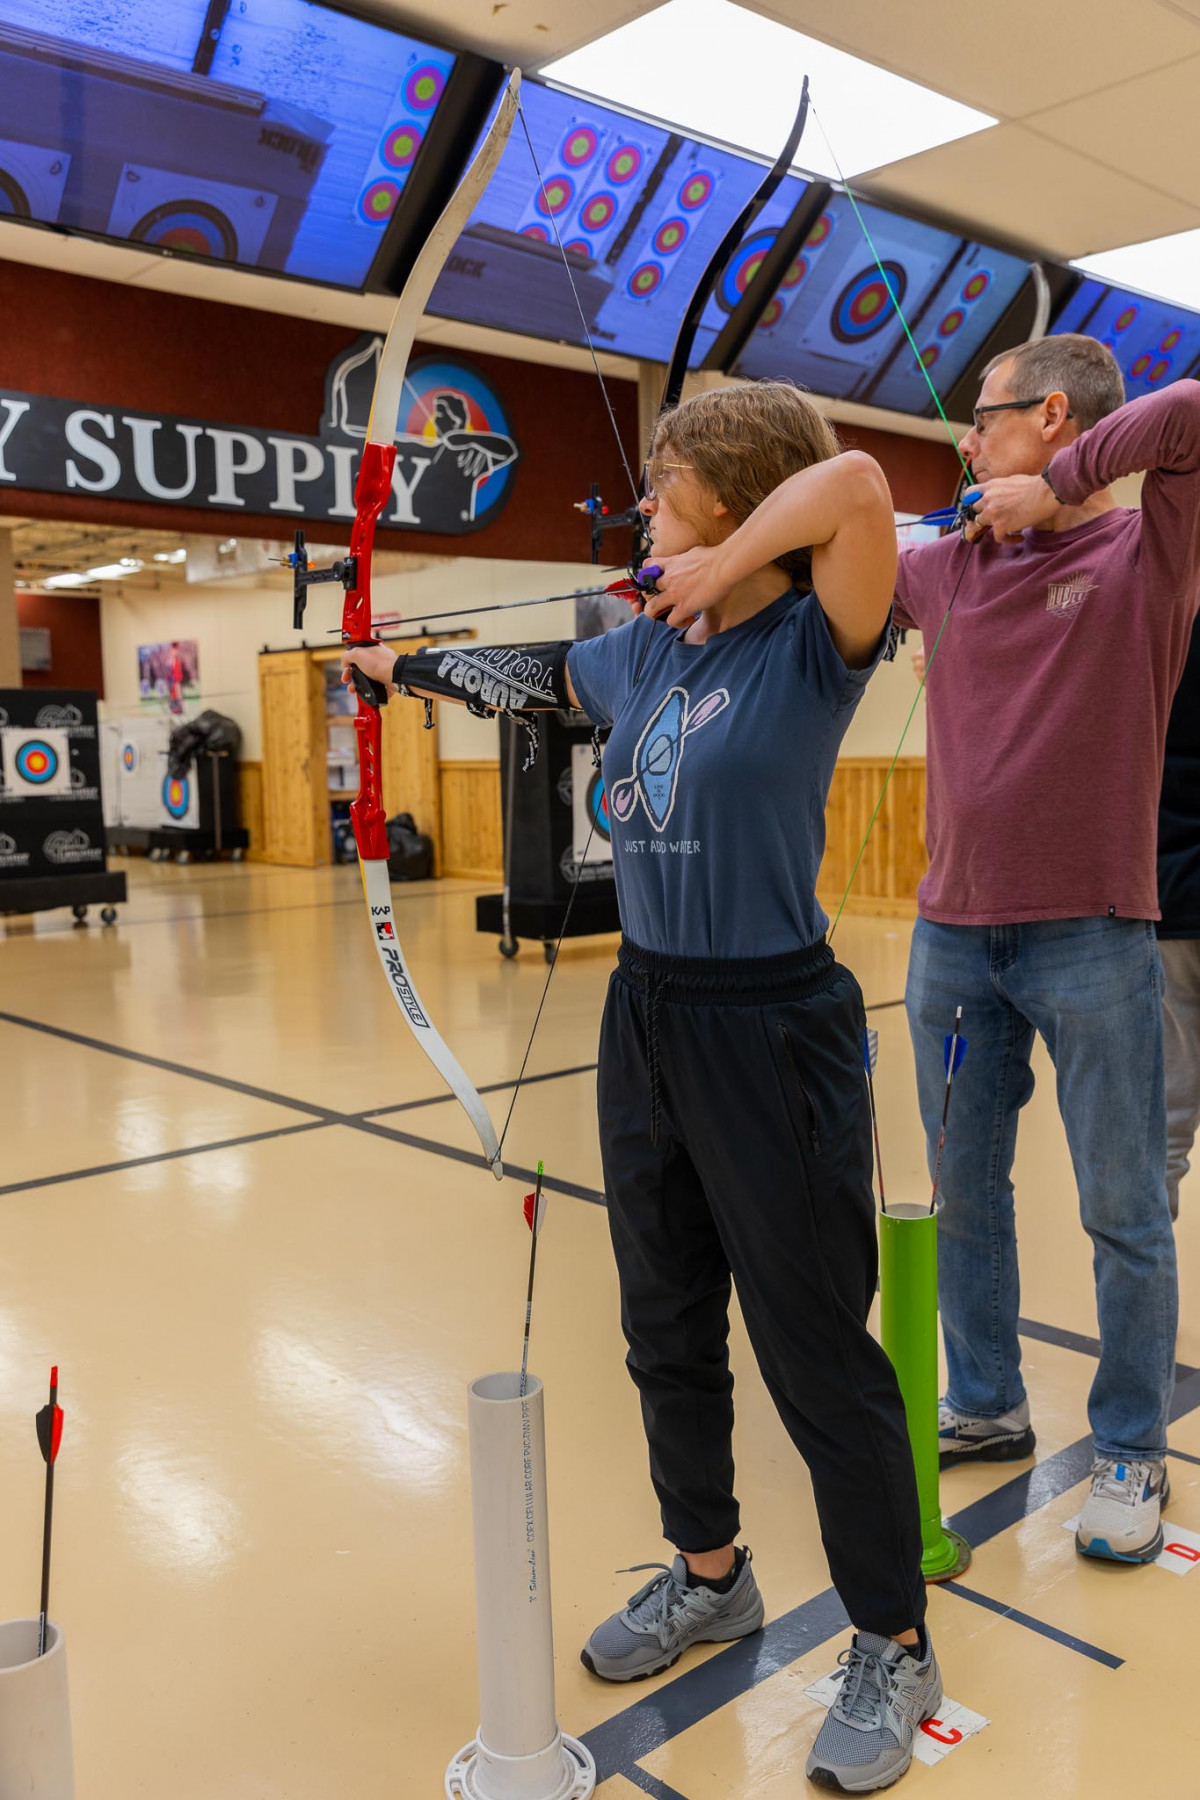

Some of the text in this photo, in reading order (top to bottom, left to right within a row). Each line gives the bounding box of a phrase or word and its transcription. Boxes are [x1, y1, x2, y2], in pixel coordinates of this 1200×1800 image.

[65, 409, 431, 524] SUPPLY
[437, 653, 528, 709] AURORA
[473, 649, 557, 697] AURORA
[625, 841, 646, 853] JUST
[650, 841, 667, 854] ADD
[371, 906, 391, 916] KAP
[920, 1718, 963, 1745] C
